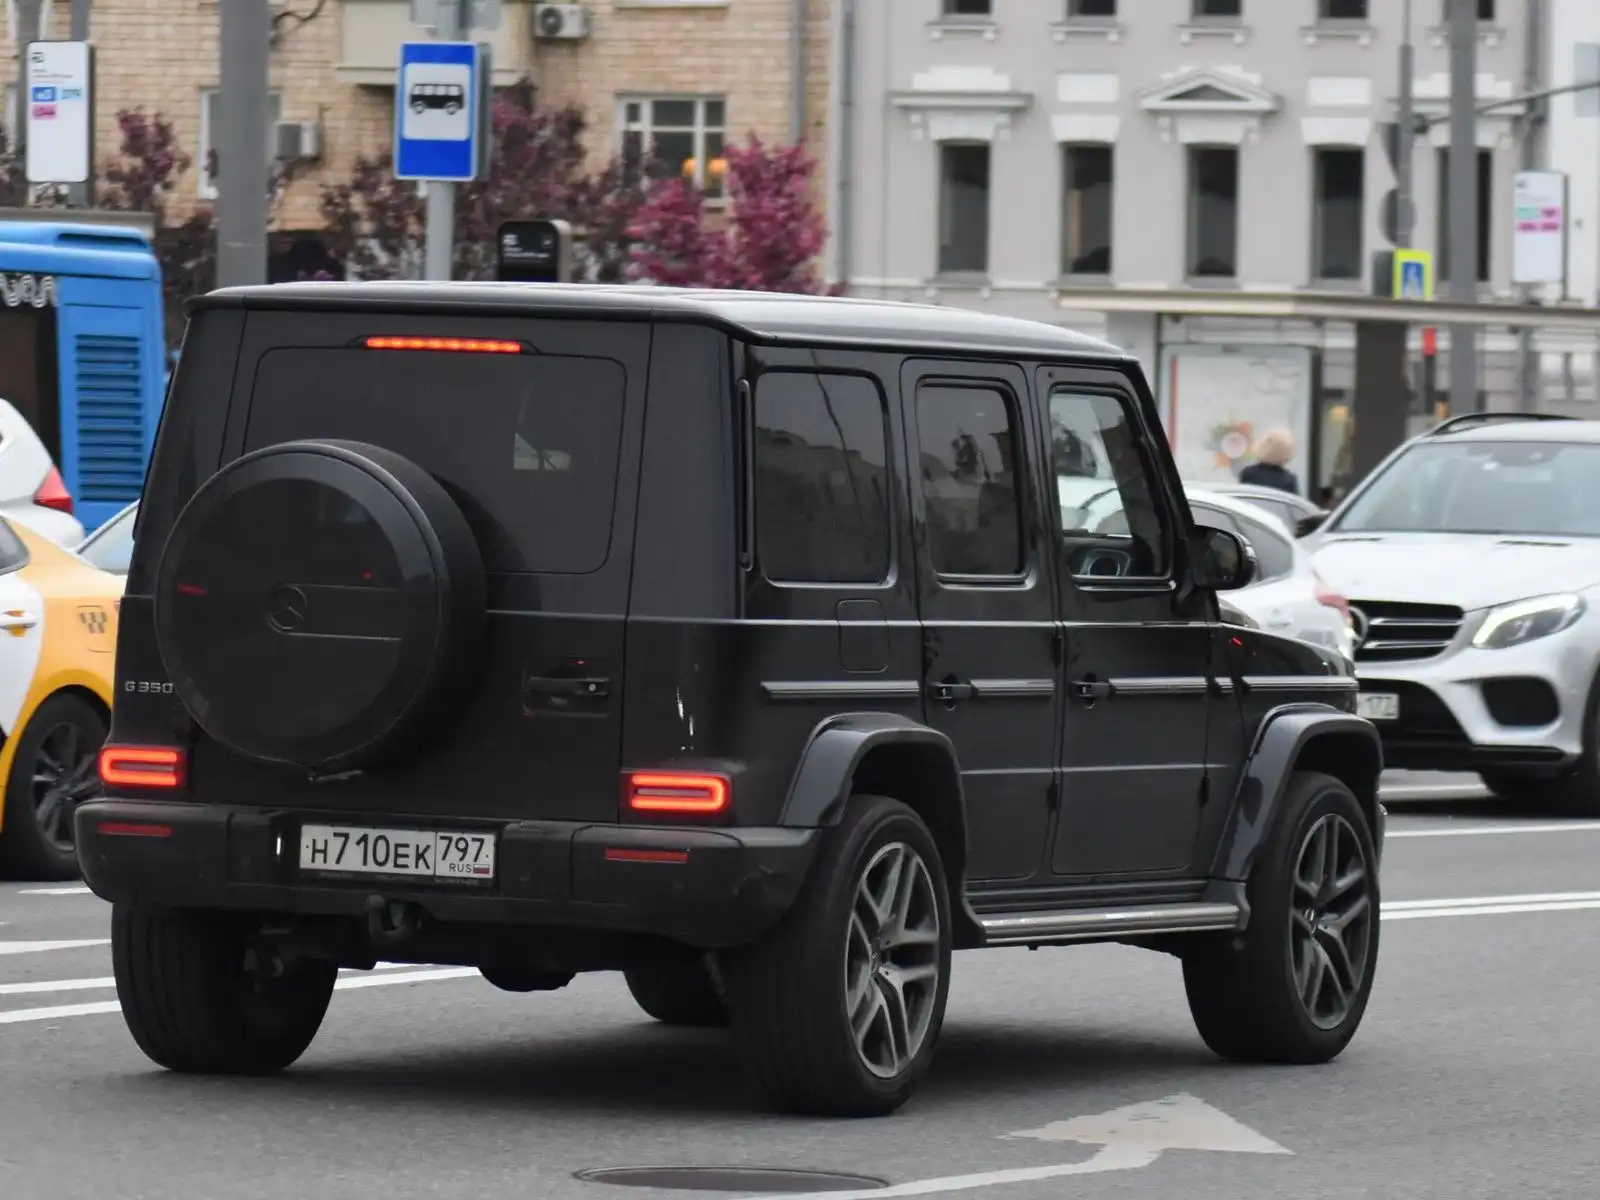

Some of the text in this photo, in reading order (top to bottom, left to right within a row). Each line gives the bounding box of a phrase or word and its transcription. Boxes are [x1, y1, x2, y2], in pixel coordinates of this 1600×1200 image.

[125, 681, 173, 694] G 350
[439, 835, 485, 863] 797
[449, 863, 473, 874] RUS
